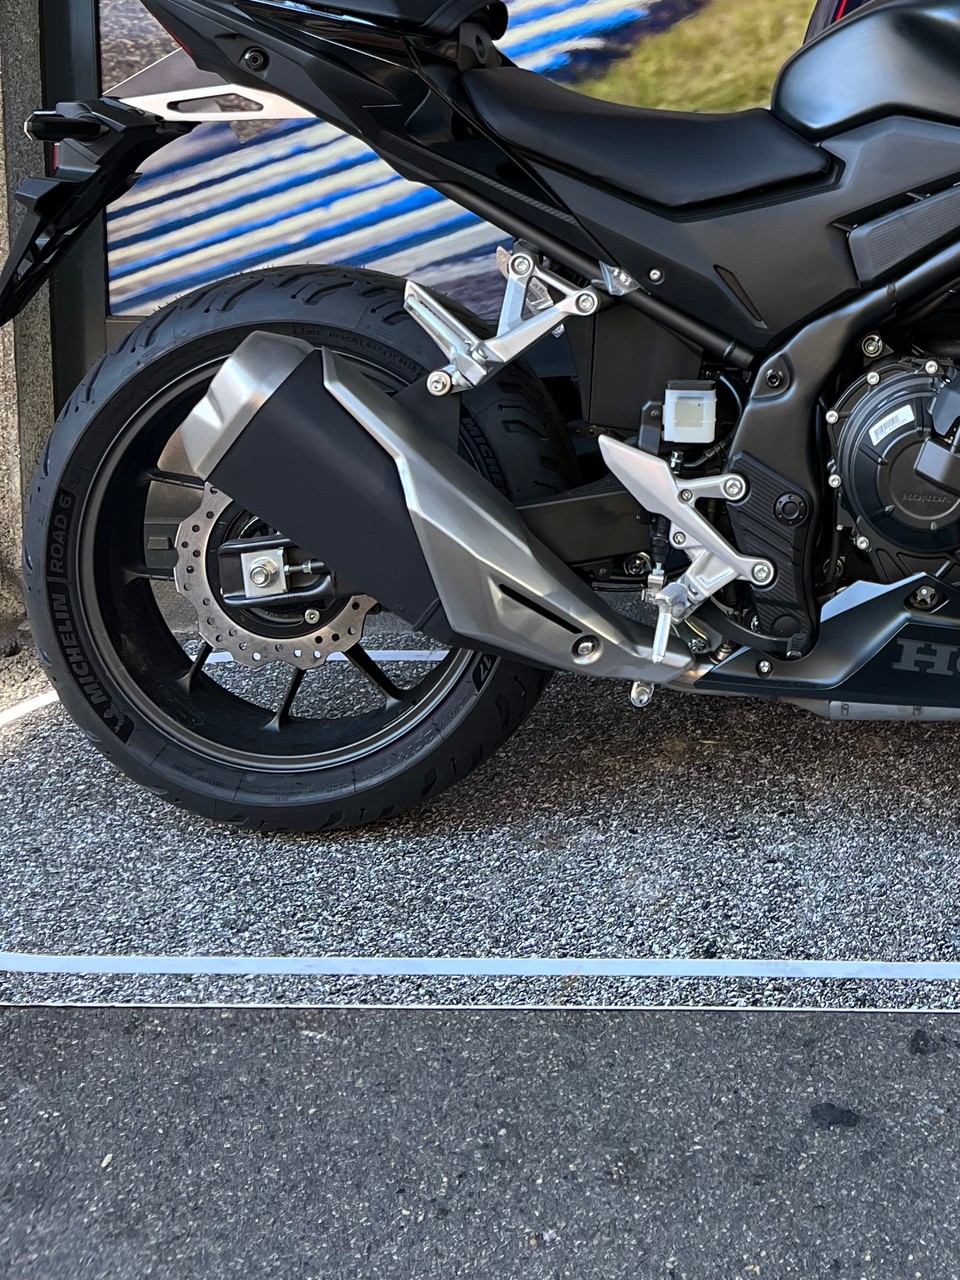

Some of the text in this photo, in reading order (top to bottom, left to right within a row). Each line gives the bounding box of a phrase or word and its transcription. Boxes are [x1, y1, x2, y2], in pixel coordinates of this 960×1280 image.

[902, 493, 952, 504] HONDA
[50, 514, 69, 577] ROAD
[51, 593, 107, 705] MICHELIN
